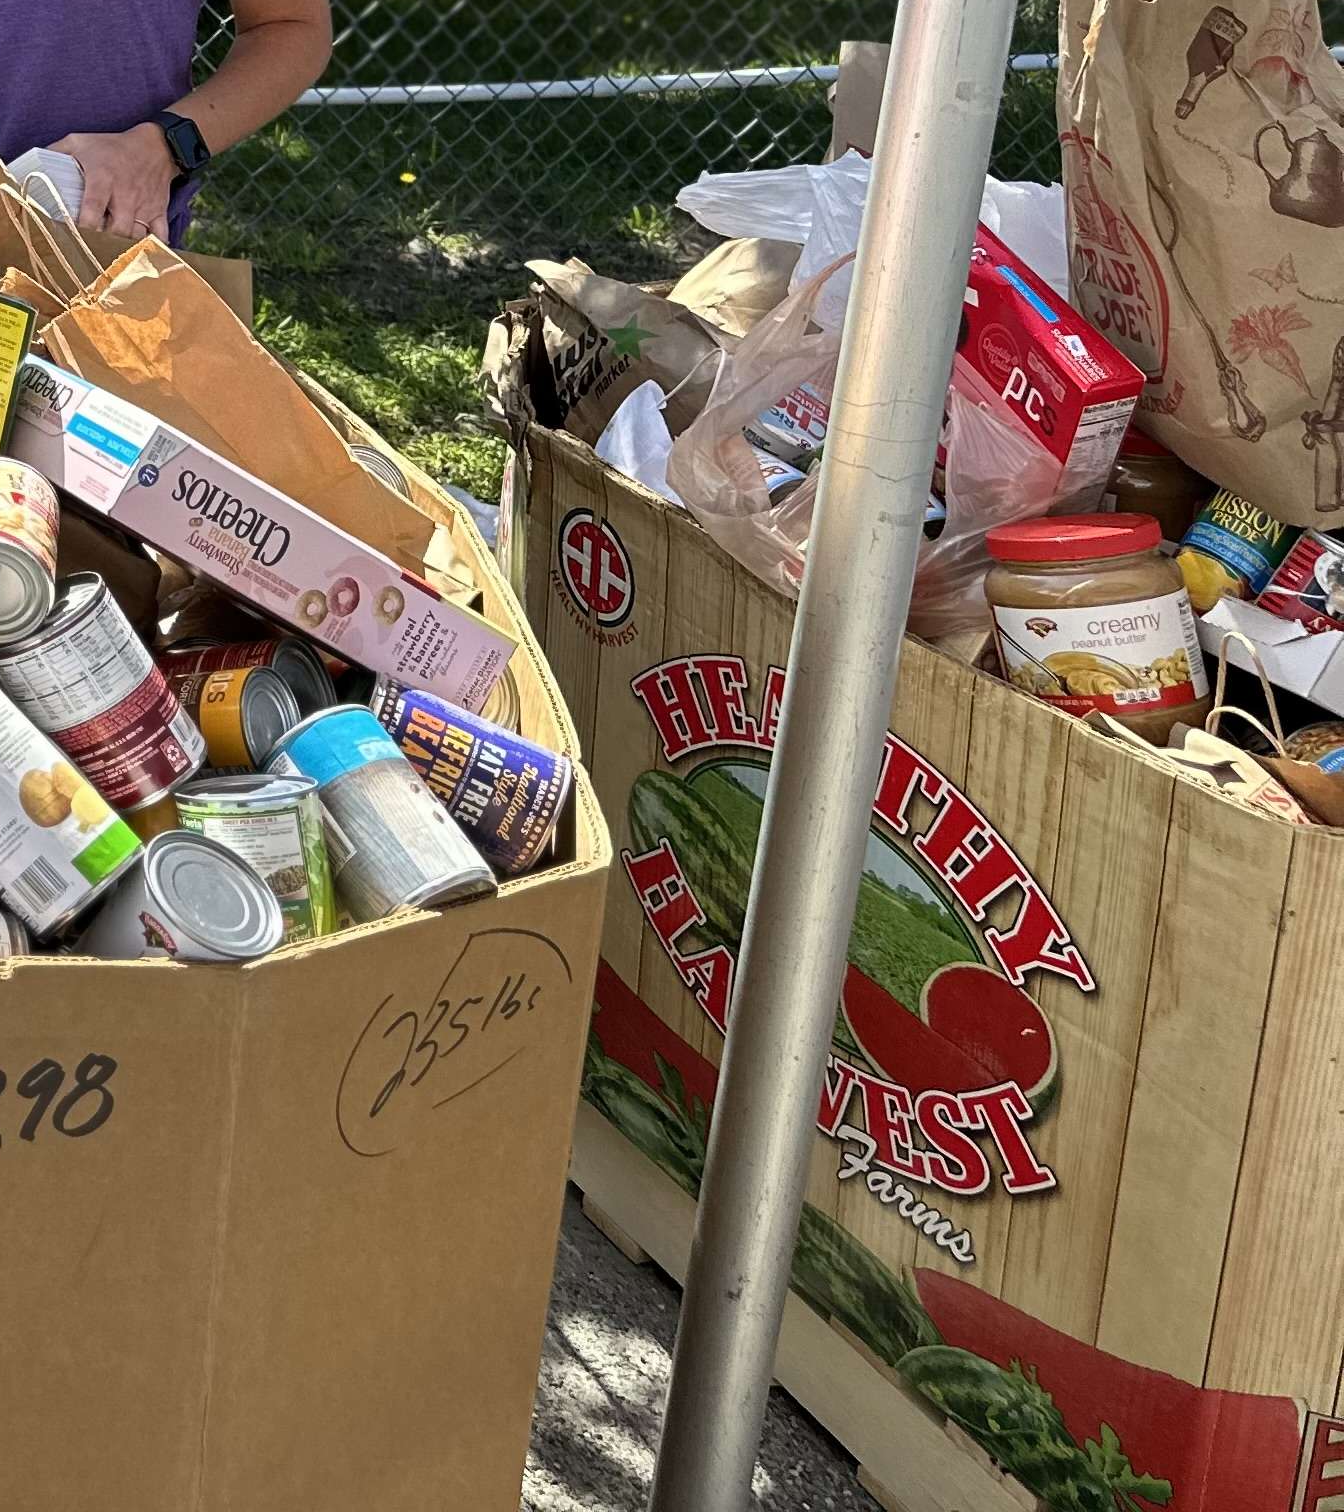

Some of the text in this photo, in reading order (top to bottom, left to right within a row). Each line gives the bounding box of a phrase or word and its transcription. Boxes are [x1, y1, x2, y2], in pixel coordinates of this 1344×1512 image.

[593, 353, 632, 400] market
[171, 468, 292, 567] Cheerios
[1212, 487, 1288, 548] MISSION
[1212, 510, 1265, 543] PRIDE
[186, 529, 245, 577] Strawberry
[208, 526, 251, 561] Banana
[401, 617, 417, 643] real
[550, 568, 640, 649] HEALTHY HARVEST
[1087, 611, 1161, 637] creamy
[396, 609, 434, 673] strawberry
[410, 621, 442, 667] banana
[419, 637, 445, 680] purees
[1071, 633, 1148, 650] peanut butter
[457, 740, 508, 828] FAT FREE
[491, 768, 518, 808] Style
[496, 761, 540, 841] Traditional
[520, 778, 551, 836] TRADER JOE'S
[835, 1124, 976, 1267] Farms
